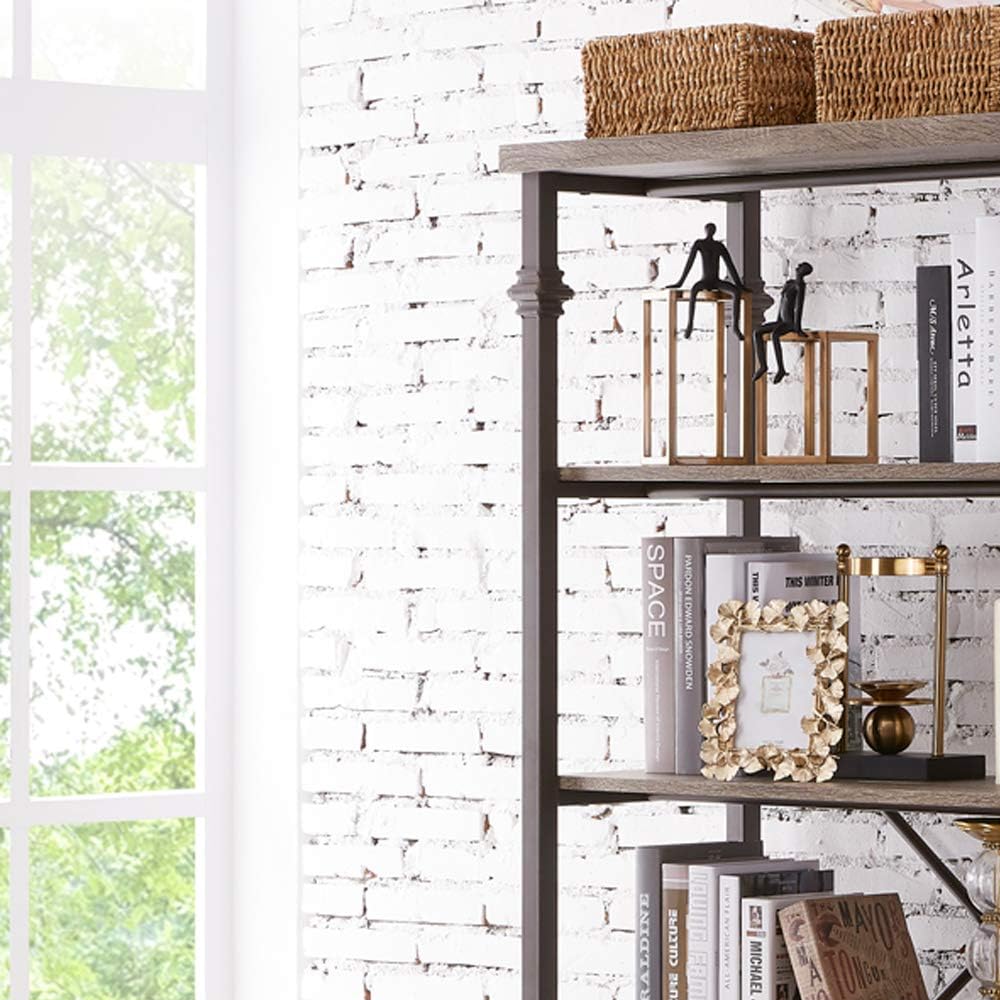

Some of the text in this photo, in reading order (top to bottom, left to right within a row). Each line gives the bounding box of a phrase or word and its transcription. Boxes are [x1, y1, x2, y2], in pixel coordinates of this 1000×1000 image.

[957, 258, 976, 388] Arletta
[647, 544, 666, 638] SPACE
[752, 571, 760, 595] THIS
[785, 575, 834, 588] THIS WINTER
[684, 554, 694, 690] PARDON EDWARD SNOWDEN
[668, 909, 679, 967] CULTURE
[750, 941, 762, 996] MICHAEL
